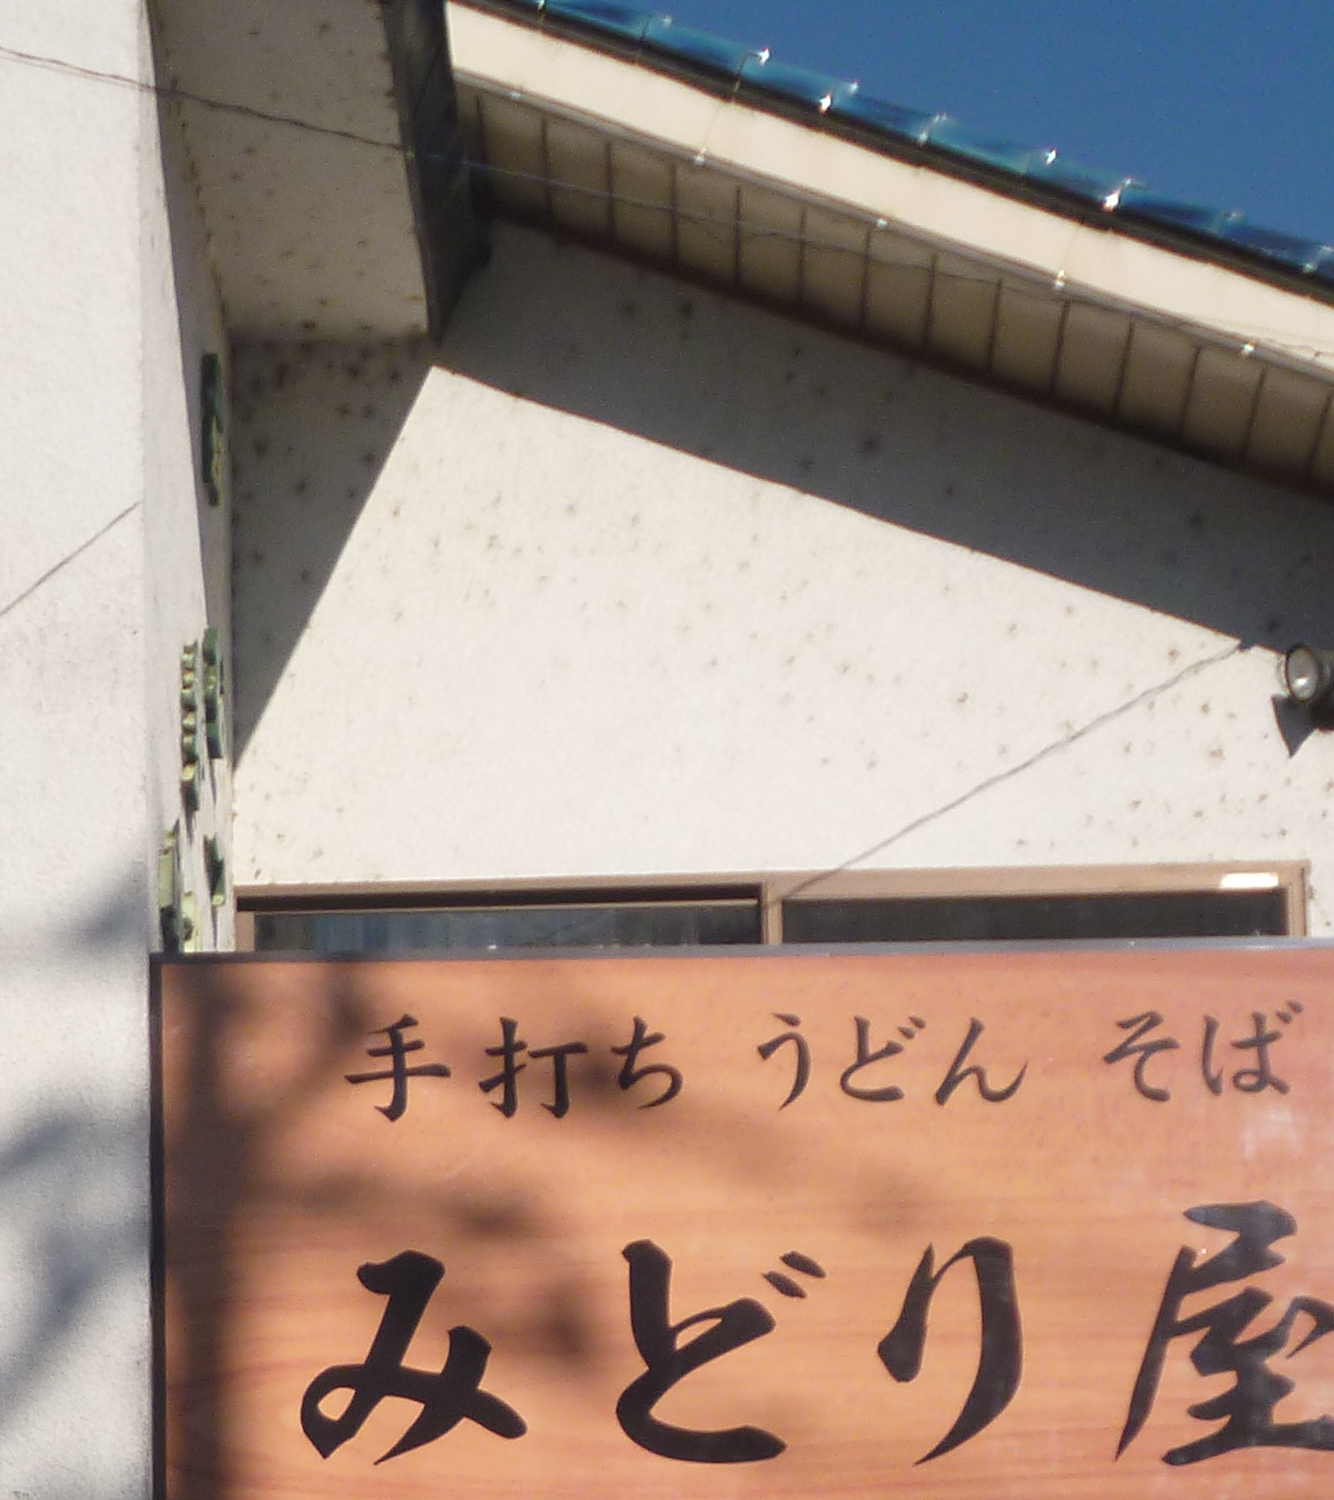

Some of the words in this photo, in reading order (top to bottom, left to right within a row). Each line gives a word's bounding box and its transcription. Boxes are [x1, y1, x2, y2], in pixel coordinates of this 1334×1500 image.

[346, 1012, 683, 1122] 手打ち
[755, 1012, 1028, 1110] うどん
[1103, 1000, 1303, 1103] そば
